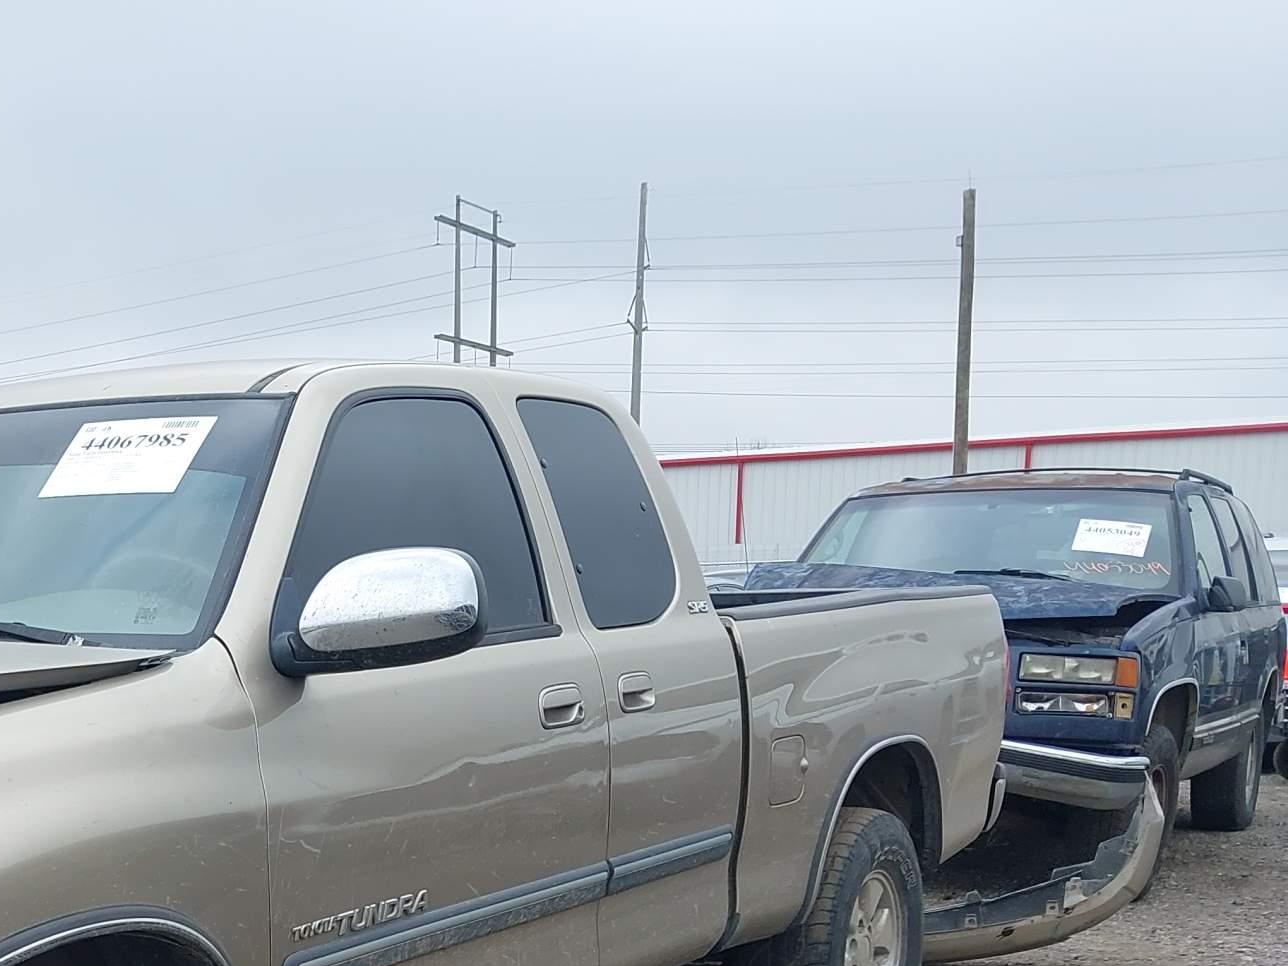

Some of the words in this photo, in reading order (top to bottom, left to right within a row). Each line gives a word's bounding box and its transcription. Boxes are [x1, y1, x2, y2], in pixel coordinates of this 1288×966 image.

[81, 432, 189, 451] 44067985
[291, 915, 338, 942] TOYOTA
[337, 889, 428, 936] TUNDRA
